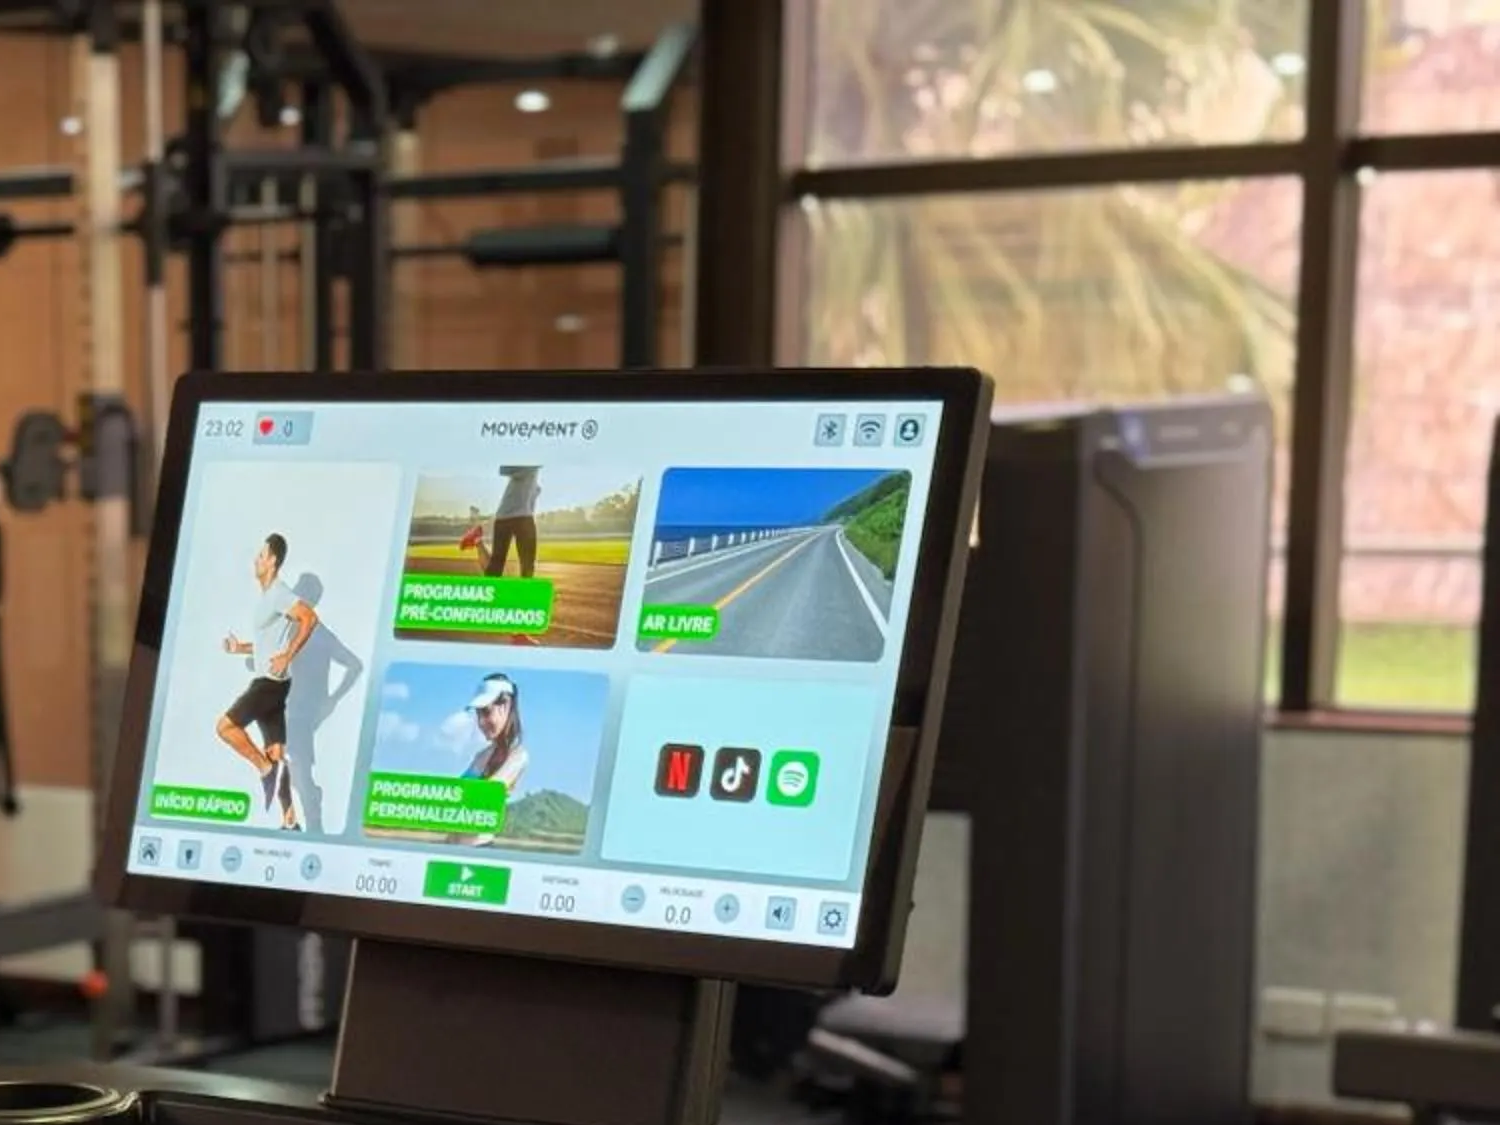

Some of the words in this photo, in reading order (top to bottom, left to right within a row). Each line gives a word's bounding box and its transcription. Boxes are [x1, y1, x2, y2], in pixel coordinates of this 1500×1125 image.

[403, 583, 496, 602] PROGRAMAS
[400, 601, 546, 626] PRÉ-CONFIGURADOS
[642, 614, 669, 632] AR
[670, 615, 715, 632] LIVRE
[371, 780, 463, 802] PROGRAMAS
[154, 790, 196, 811] INÍCIO
[196, 792, 246, 814] RÁPIDO
[368, 800, 498, 828] PERSONALIZÁVEIS
[447, 882, 484, 897] START
[539, 892, 576, 913] 0.00
[664, 904, 692, 925] 0.0
